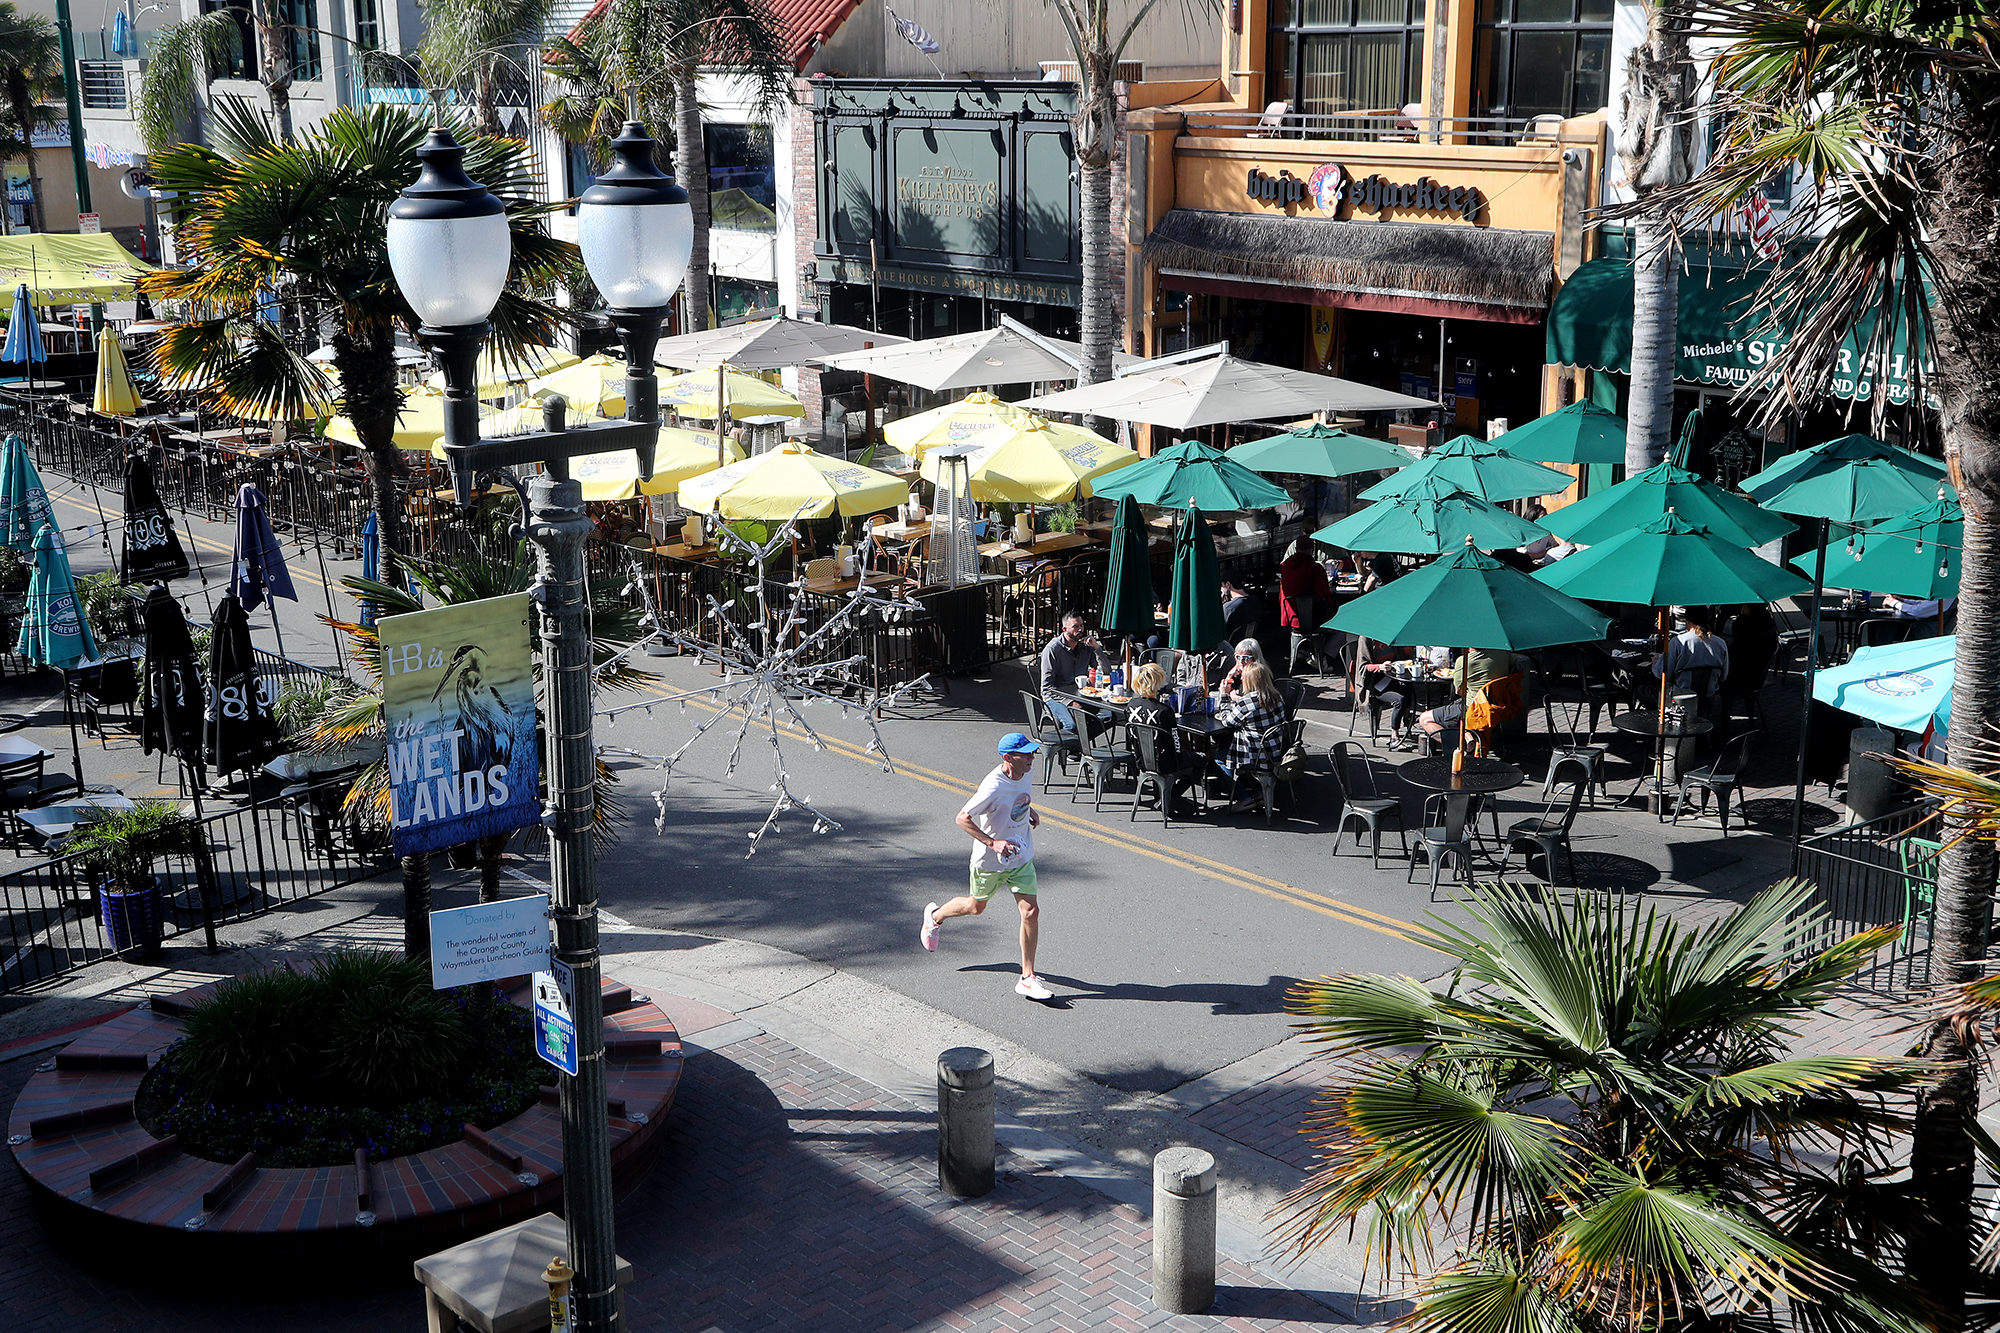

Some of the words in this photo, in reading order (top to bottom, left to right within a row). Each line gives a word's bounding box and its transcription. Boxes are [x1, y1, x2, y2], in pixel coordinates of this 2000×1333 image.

[952, 169, 973, 177] 1999
[9, 190, 30, 200] PIER
[1246, 165, 1305, 208] baja
[1350, 174, 1480, 222] sharkeez
[913, 202, 952, 217] IRISH
[956, 205, 982, 219] PUB
[834, 266, 863, 279] FOOD
[877, 270, 895, 282] ALE
[899, 272, 936, 287] HOUSE
[954, 278, 1001, 293] SPORTS
[1015, 284, 1068, 299] SPIRITS
[1683, 339, 1744, 358] Michele's
[1747, 340, 1852, 374] SUR
[1705, 365, 1756, 382] FAMILY
[387, 642, 423, 677] HB
[427, 647, 444, 669] is
[394, 717, 424, 738] the
[387, 730, 464, 786] WET
[391, 764, 509, 830] LANDS
[465, 910, 503, 925] Donated
[506, 909, 516, 920] by
[446, 940, 460, 949] The
[461, 933, 498, 946] wonderful
[500, 930, 526, 940] women
[528, 926, 537, 935] of
[456, 949, 468, 957] the
[470, 945, 499, 955] Orange
[501, 940, 527, 950] County
[440, 958, 485, 971] Waymakers
[487, 951, 521, 962] Luncheon
[523, 946, 543, 957] Guild
[537, 1008, 545, 1020] ALL
